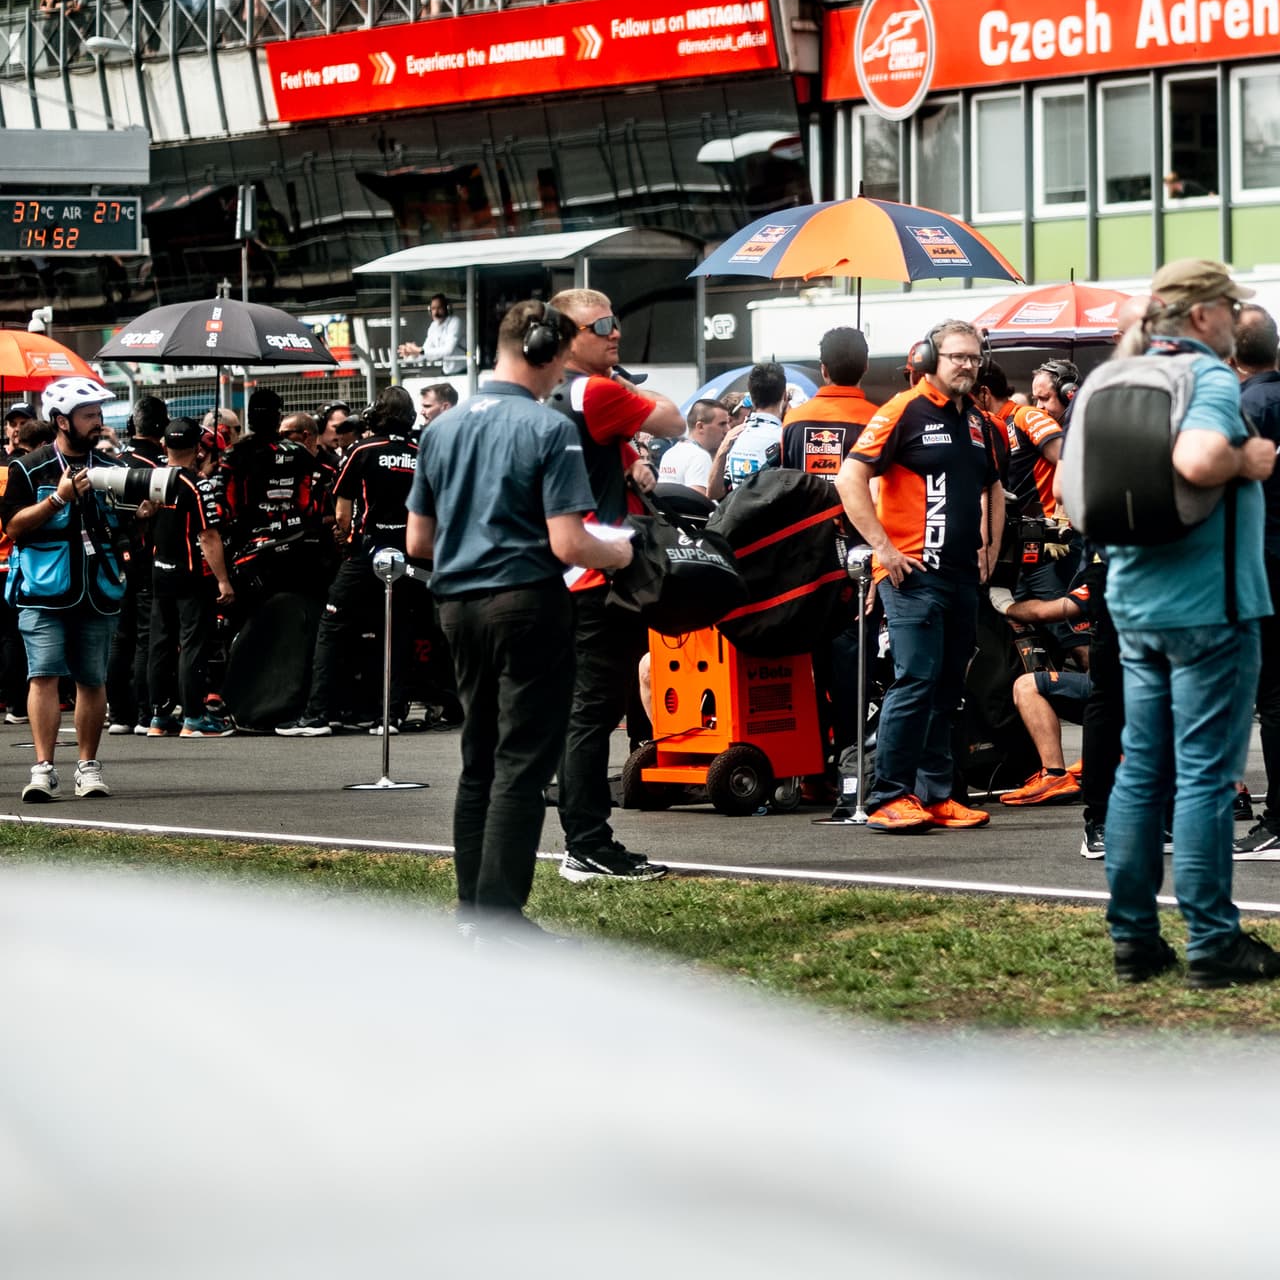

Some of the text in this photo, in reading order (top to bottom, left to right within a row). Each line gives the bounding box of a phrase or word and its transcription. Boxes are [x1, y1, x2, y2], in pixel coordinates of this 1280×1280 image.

[611, 1, 764, 39] Follow us on INSTAGRAM
[406, 36, 565, 77] Experience the ADRENALINE
[280, 63, 360, 90] Feel the SPEED
[13, 201, 39, 223] 37
[62, 206, 82, 219] AIR
[93, 202, 120, 224] 27
[265, 333, 313, 349] aprilia
[379, 452, 418, 470] aprilia
[811, 459, 837, 470] KTM
